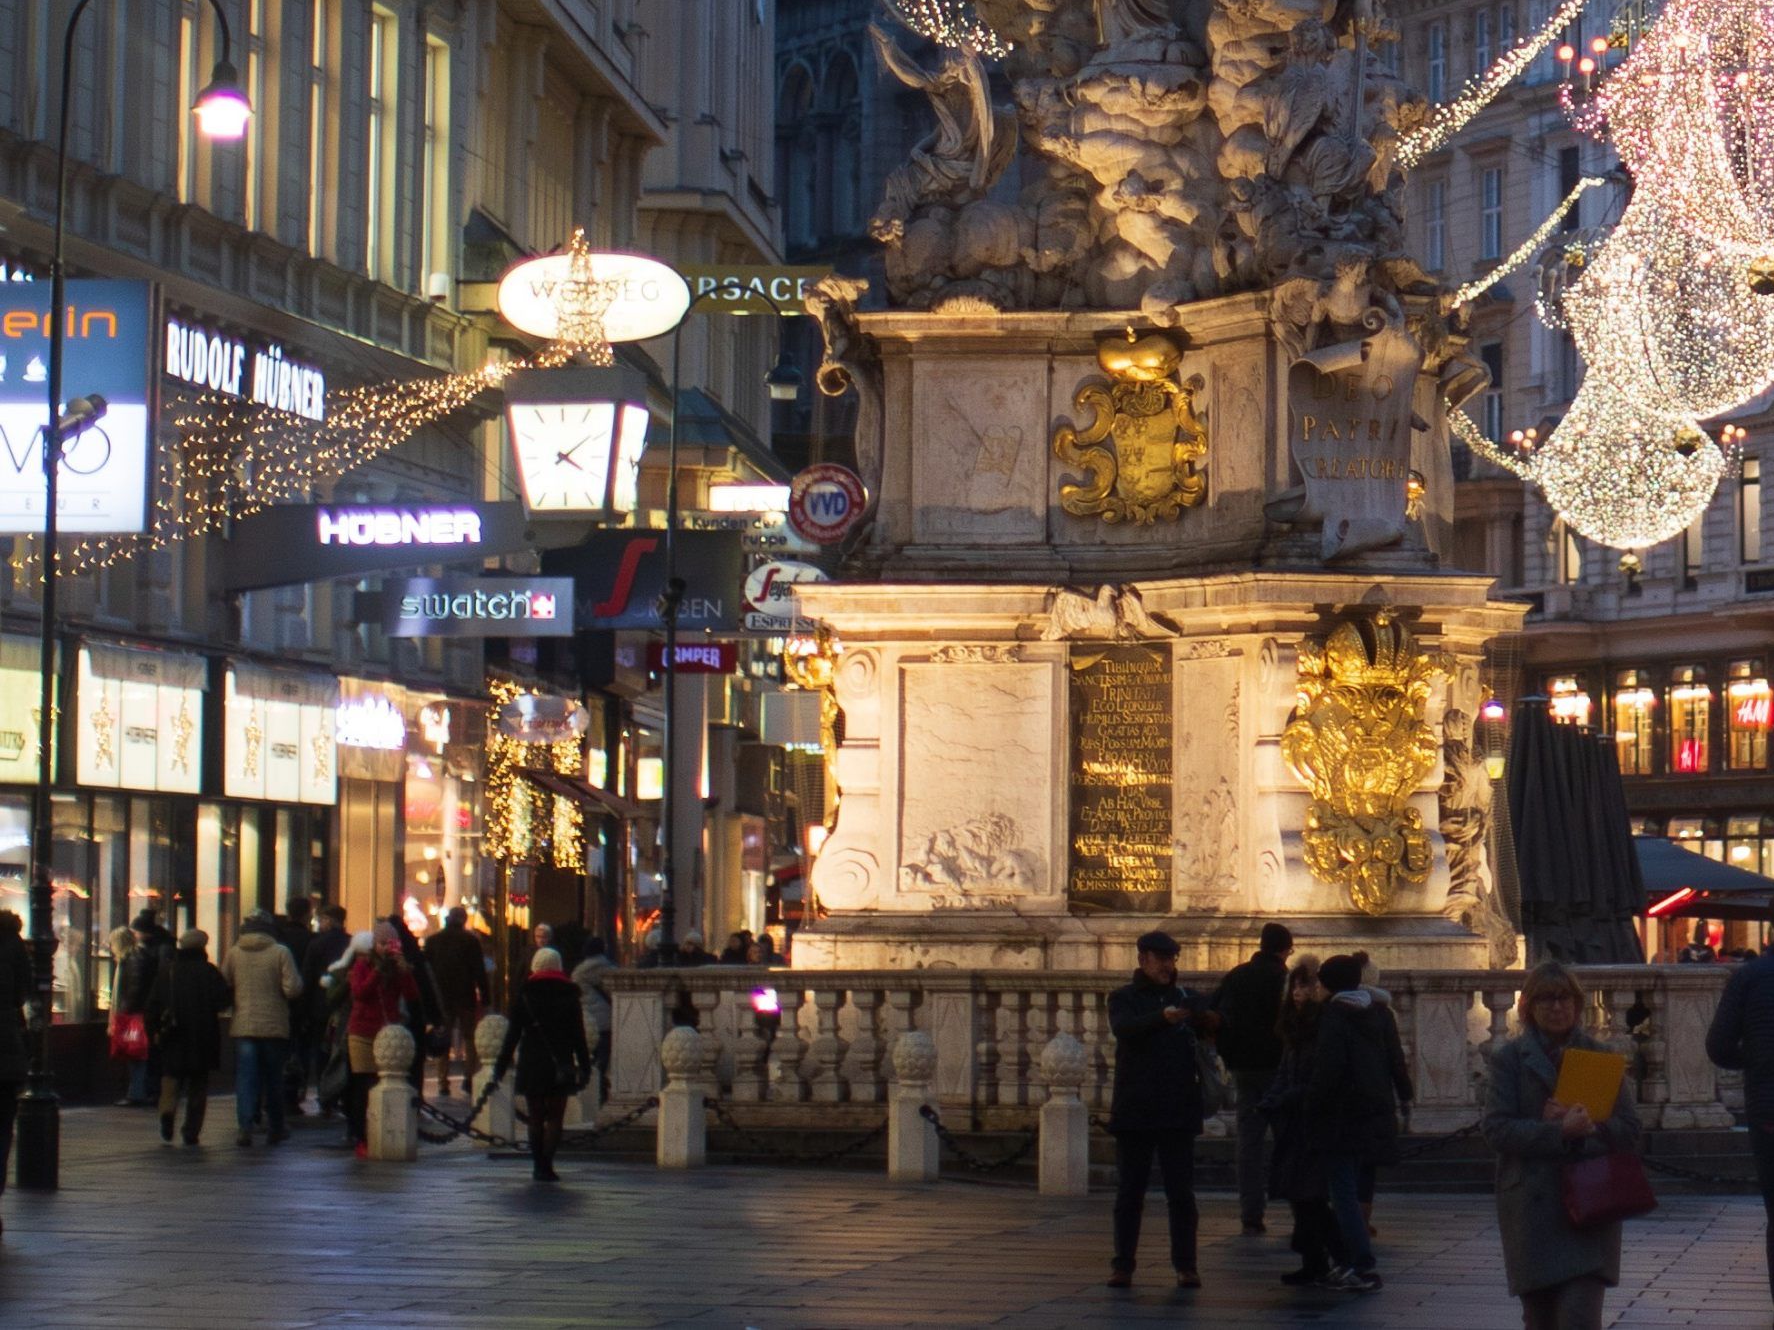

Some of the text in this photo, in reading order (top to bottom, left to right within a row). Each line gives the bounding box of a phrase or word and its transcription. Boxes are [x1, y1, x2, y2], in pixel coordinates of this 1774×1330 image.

[167, 321, 325, 421] RUDOLF HÜBNER
[400, 589, 532, 619] swatch
